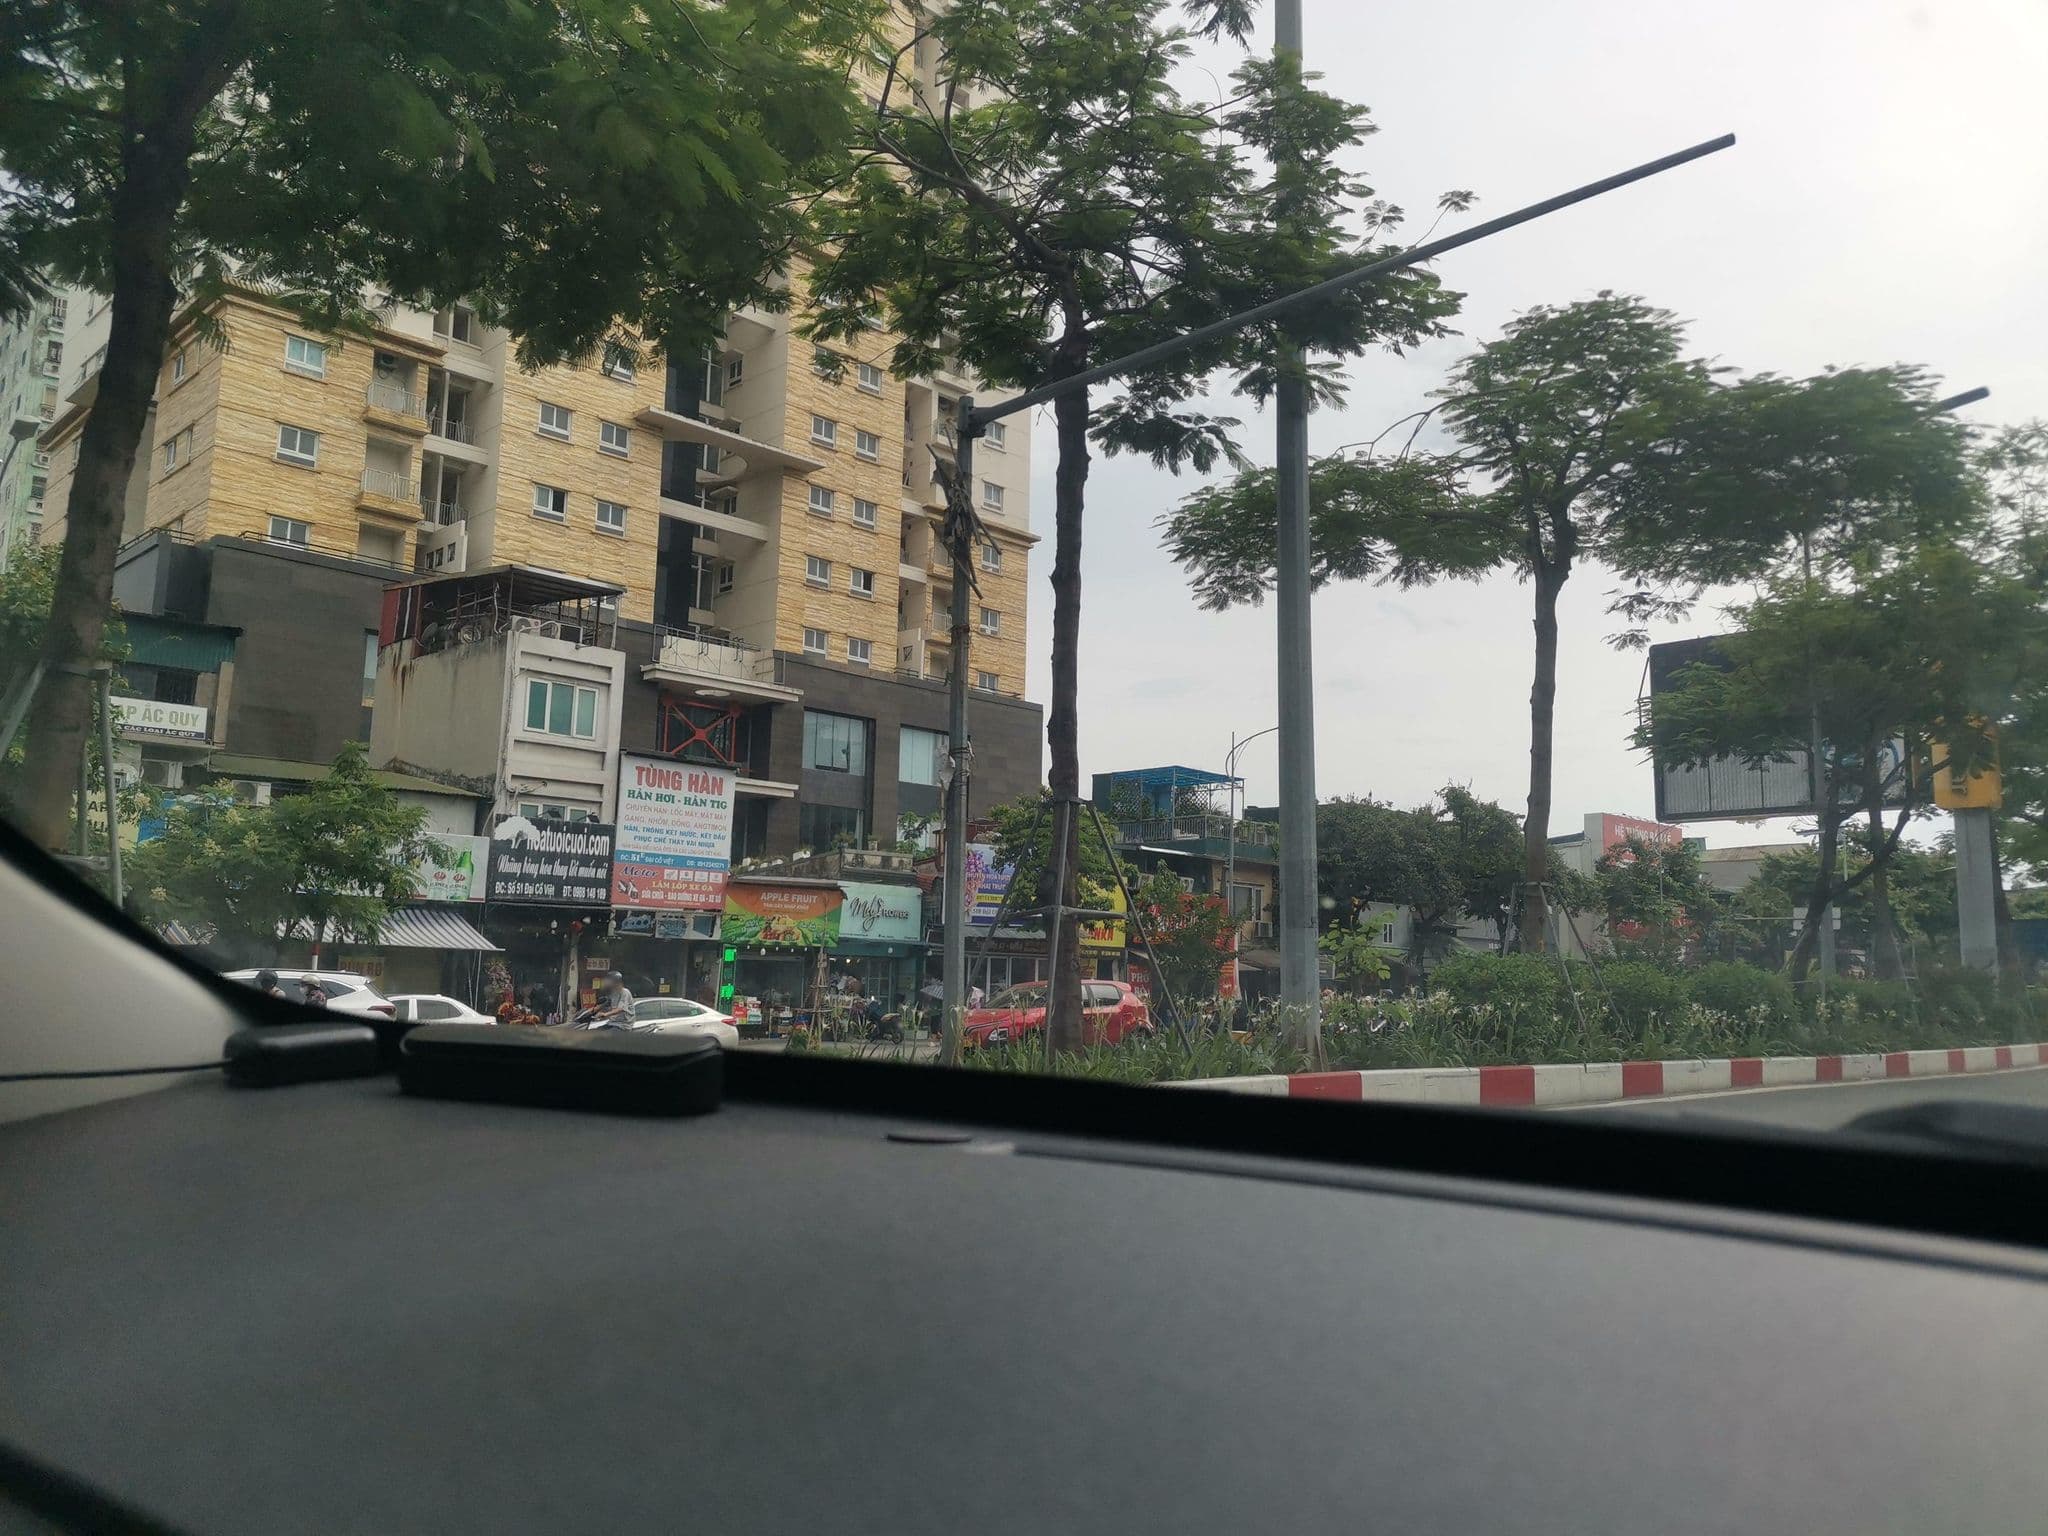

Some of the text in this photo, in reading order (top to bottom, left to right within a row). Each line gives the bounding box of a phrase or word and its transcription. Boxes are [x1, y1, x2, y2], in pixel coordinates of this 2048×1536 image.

[168, 711, 200, 728] QUY
[635, 763, 724, 796] TÙNG HÀN
[627, 788, 652, 801] HÀN
[655, 792, 675, 804] HƠI
[683, 795, 706, 808] HÀN
[710, 800, 728, 810] TIG
[516, 882, 524, 894] 51
[761, 892, 818, 904] APPLE FRUIT
